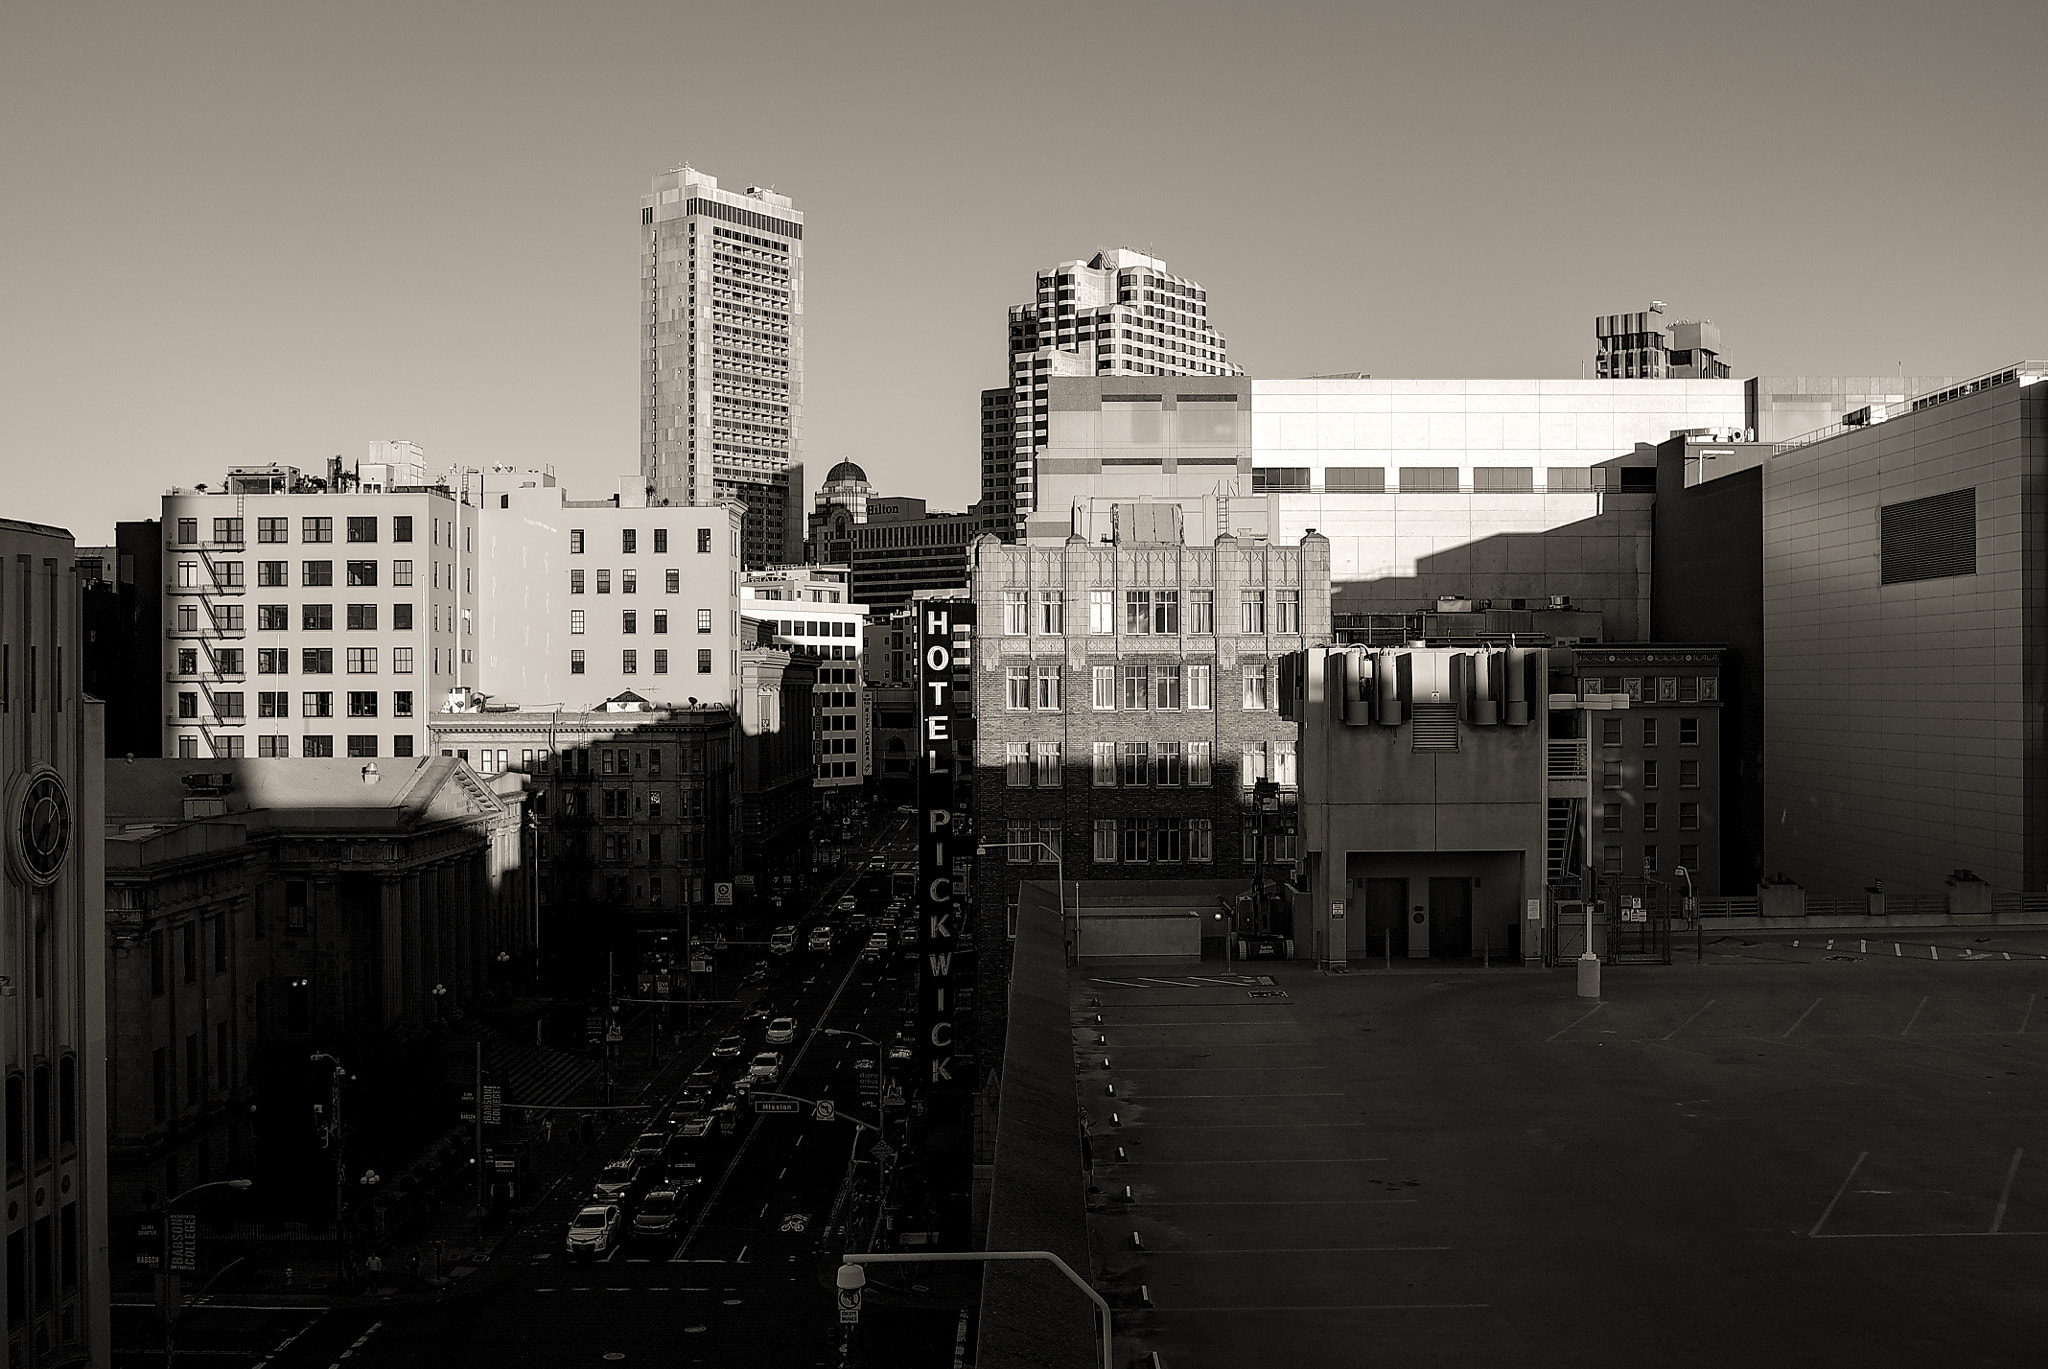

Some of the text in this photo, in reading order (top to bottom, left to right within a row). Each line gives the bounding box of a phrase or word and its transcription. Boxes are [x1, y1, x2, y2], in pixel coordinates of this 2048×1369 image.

[867, 503, 899, 515] Hilton
[927, 610, 952, 1084] HOTEL PICKWICK
[136, 1256, 160, 1264] BABSON
[171, 1218, 184, 1265] BABSON
[184, 1218, 196, 1266] COLLEGE
